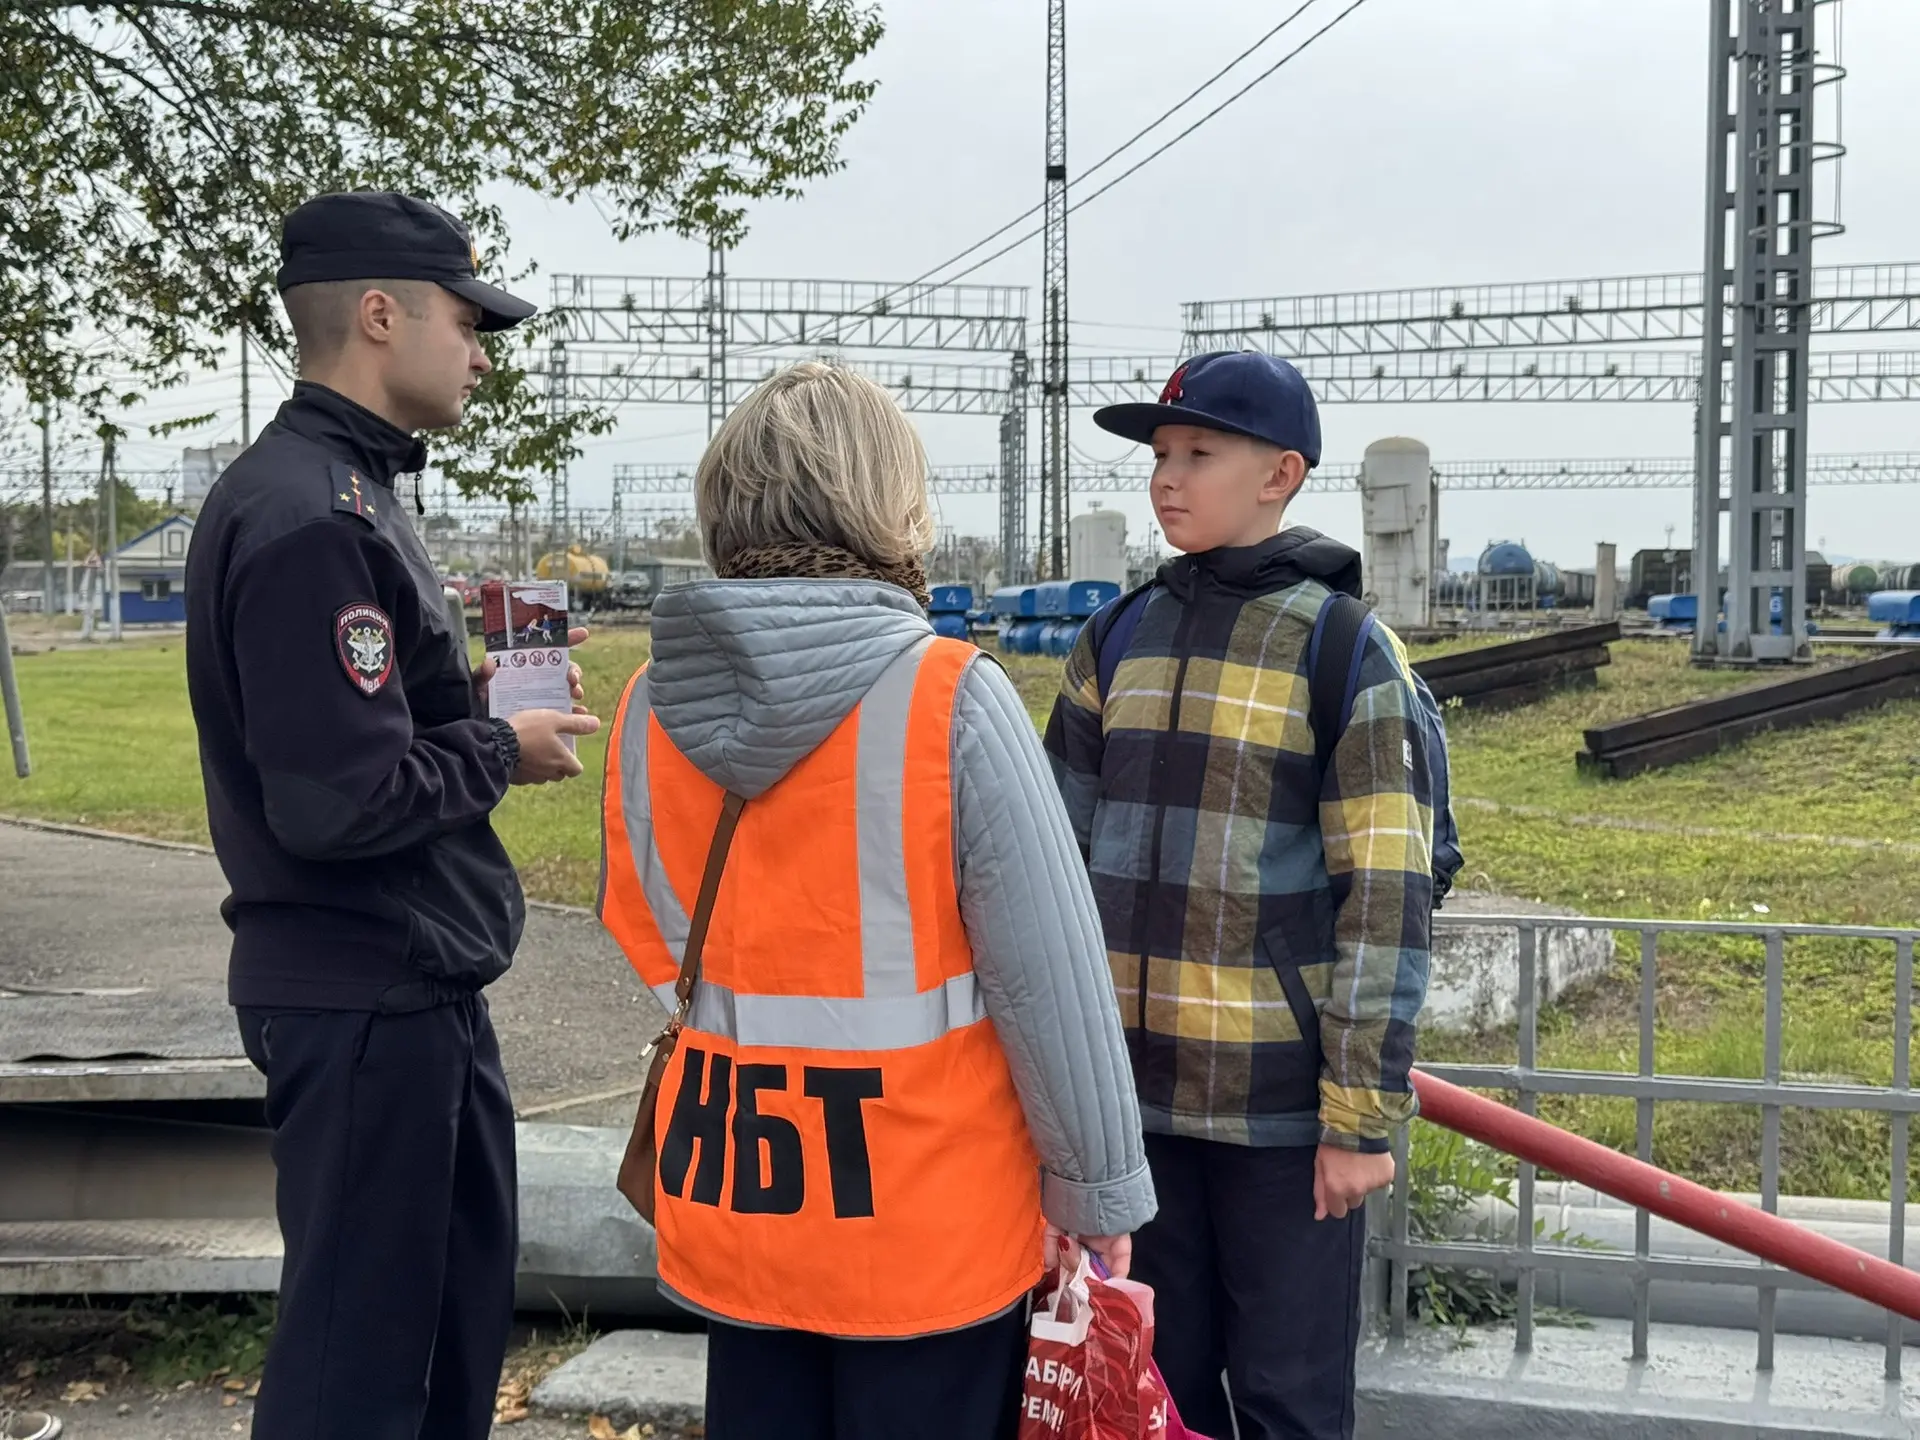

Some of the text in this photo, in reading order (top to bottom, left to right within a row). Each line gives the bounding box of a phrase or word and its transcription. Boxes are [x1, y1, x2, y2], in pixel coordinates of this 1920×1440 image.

[946, 590, 960, 606] 4
[1086, 589, 1101, 607] 3
[340, 608, 388, 628] ПОЛИЦИЯ
[360, 676, 380, 693] МВД
[659, 1046, 884, 1219] НБТ
